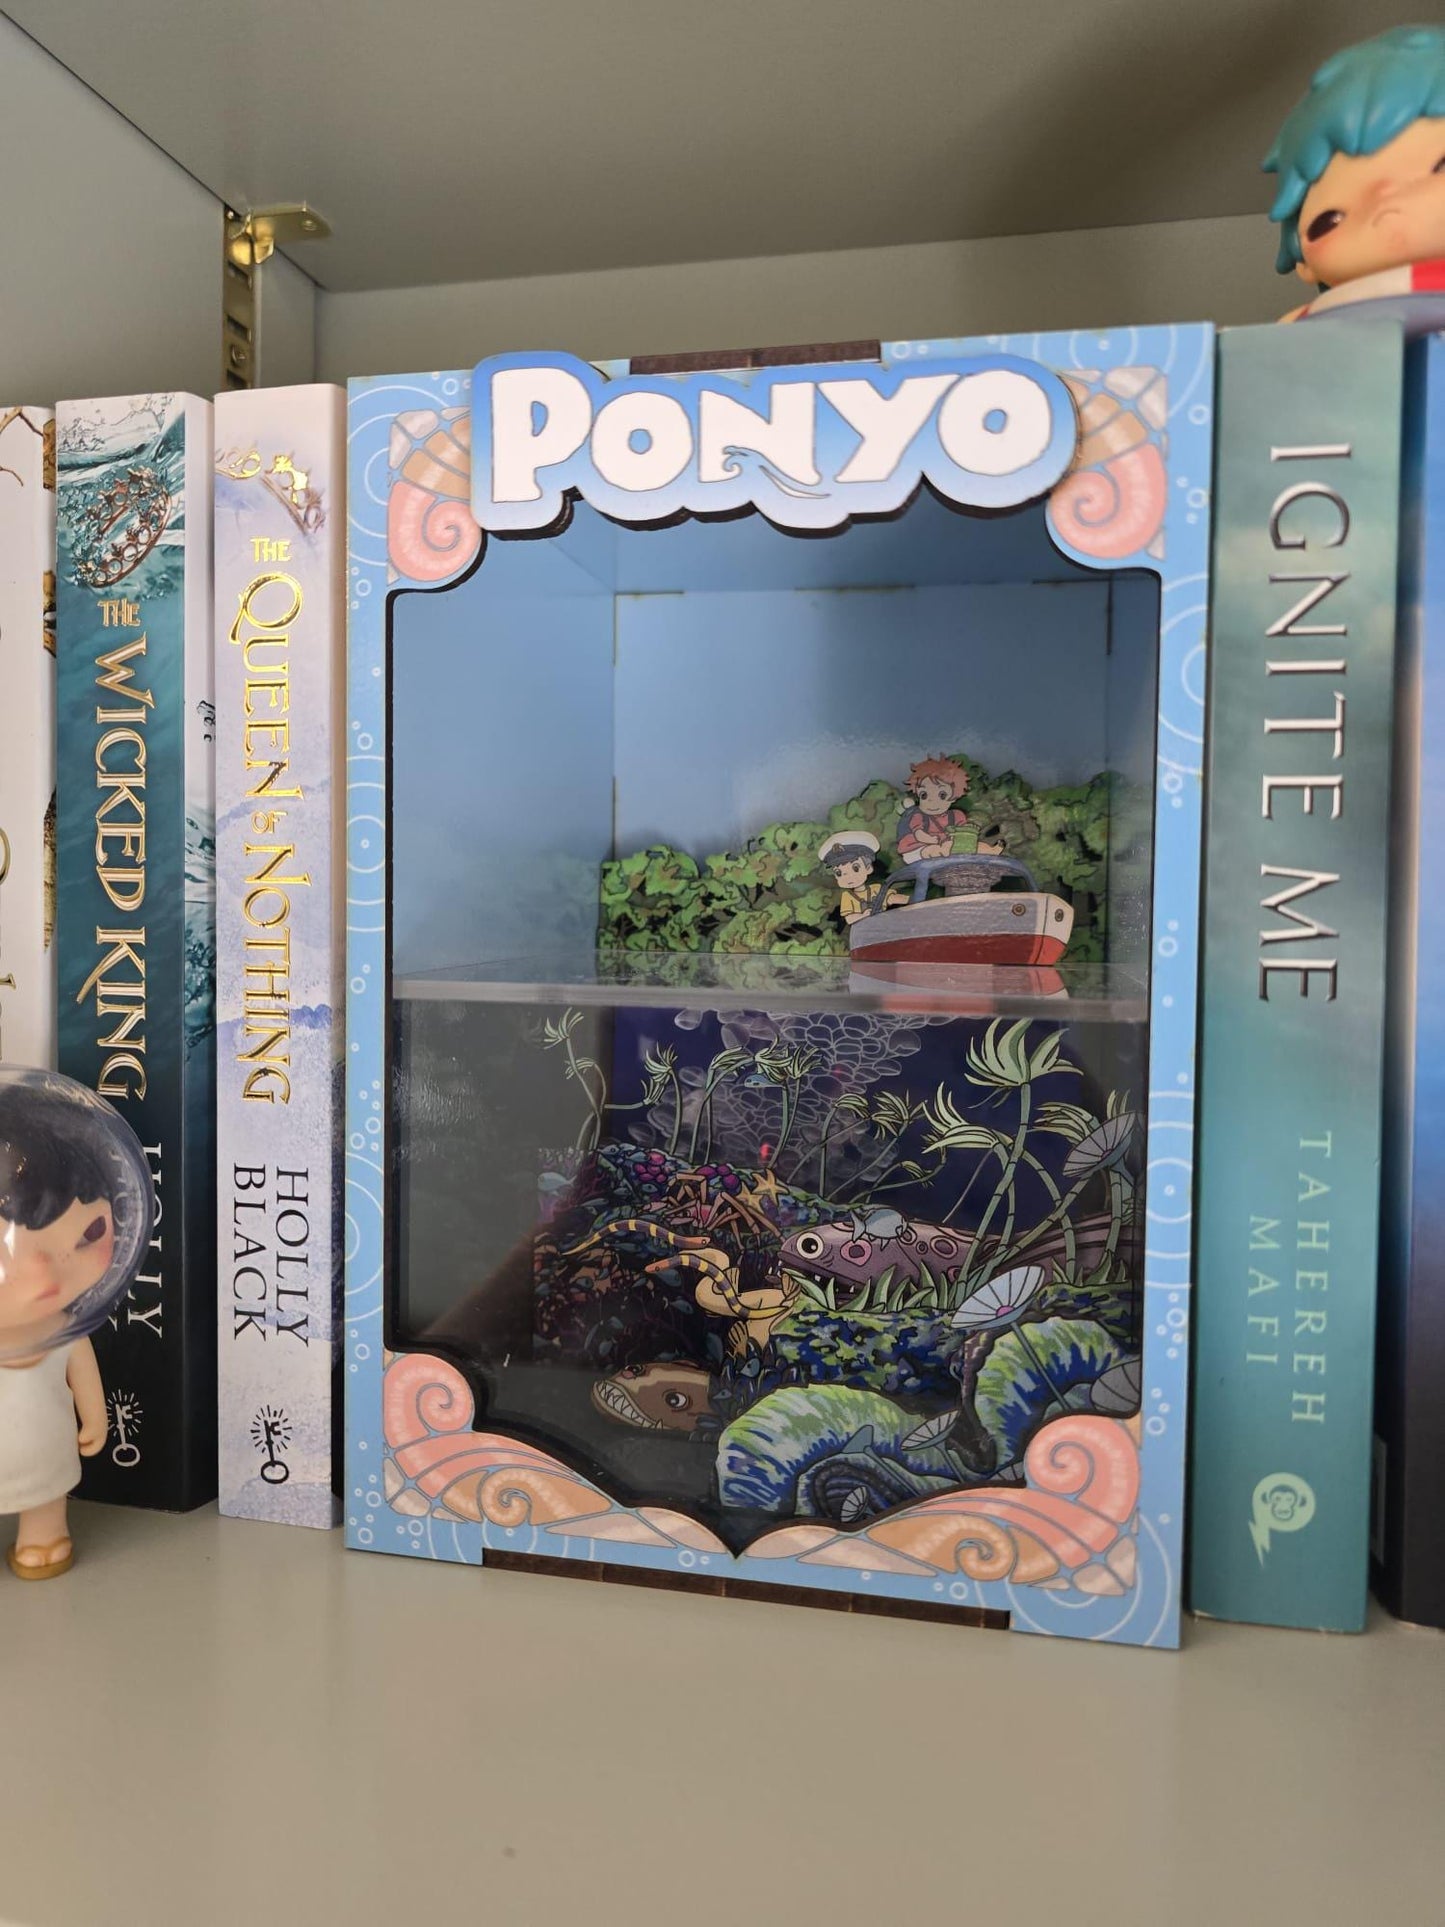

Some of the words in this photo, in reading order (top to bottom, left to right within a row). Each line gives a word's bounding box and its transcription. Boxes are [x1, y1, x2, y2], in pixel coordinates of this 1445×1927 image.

[491, 366, 1052, 504] PONYO
[97, 598, 141, 628] THE
[249, 536, 292, 563] THE
[1261, 442, 1353, 820] IGNITE
[95, 631, 155, 912] WICKED
[229, 570, 305, 801] QUEEN
[251, 810, 288, 835] OF
[77, 925, 148, 1102] KING
[236, 843, 312, 1105] NOTHING
[1258, 863, 1341, 1002] ME
[233, 1162, 267, 1342] BLACK
[275, 1166, 310, 1347] HOLLY
[1246, 1216, 1281, 1364] MAFI
[1292, 1131, 1332, 1424] TAHEREH
